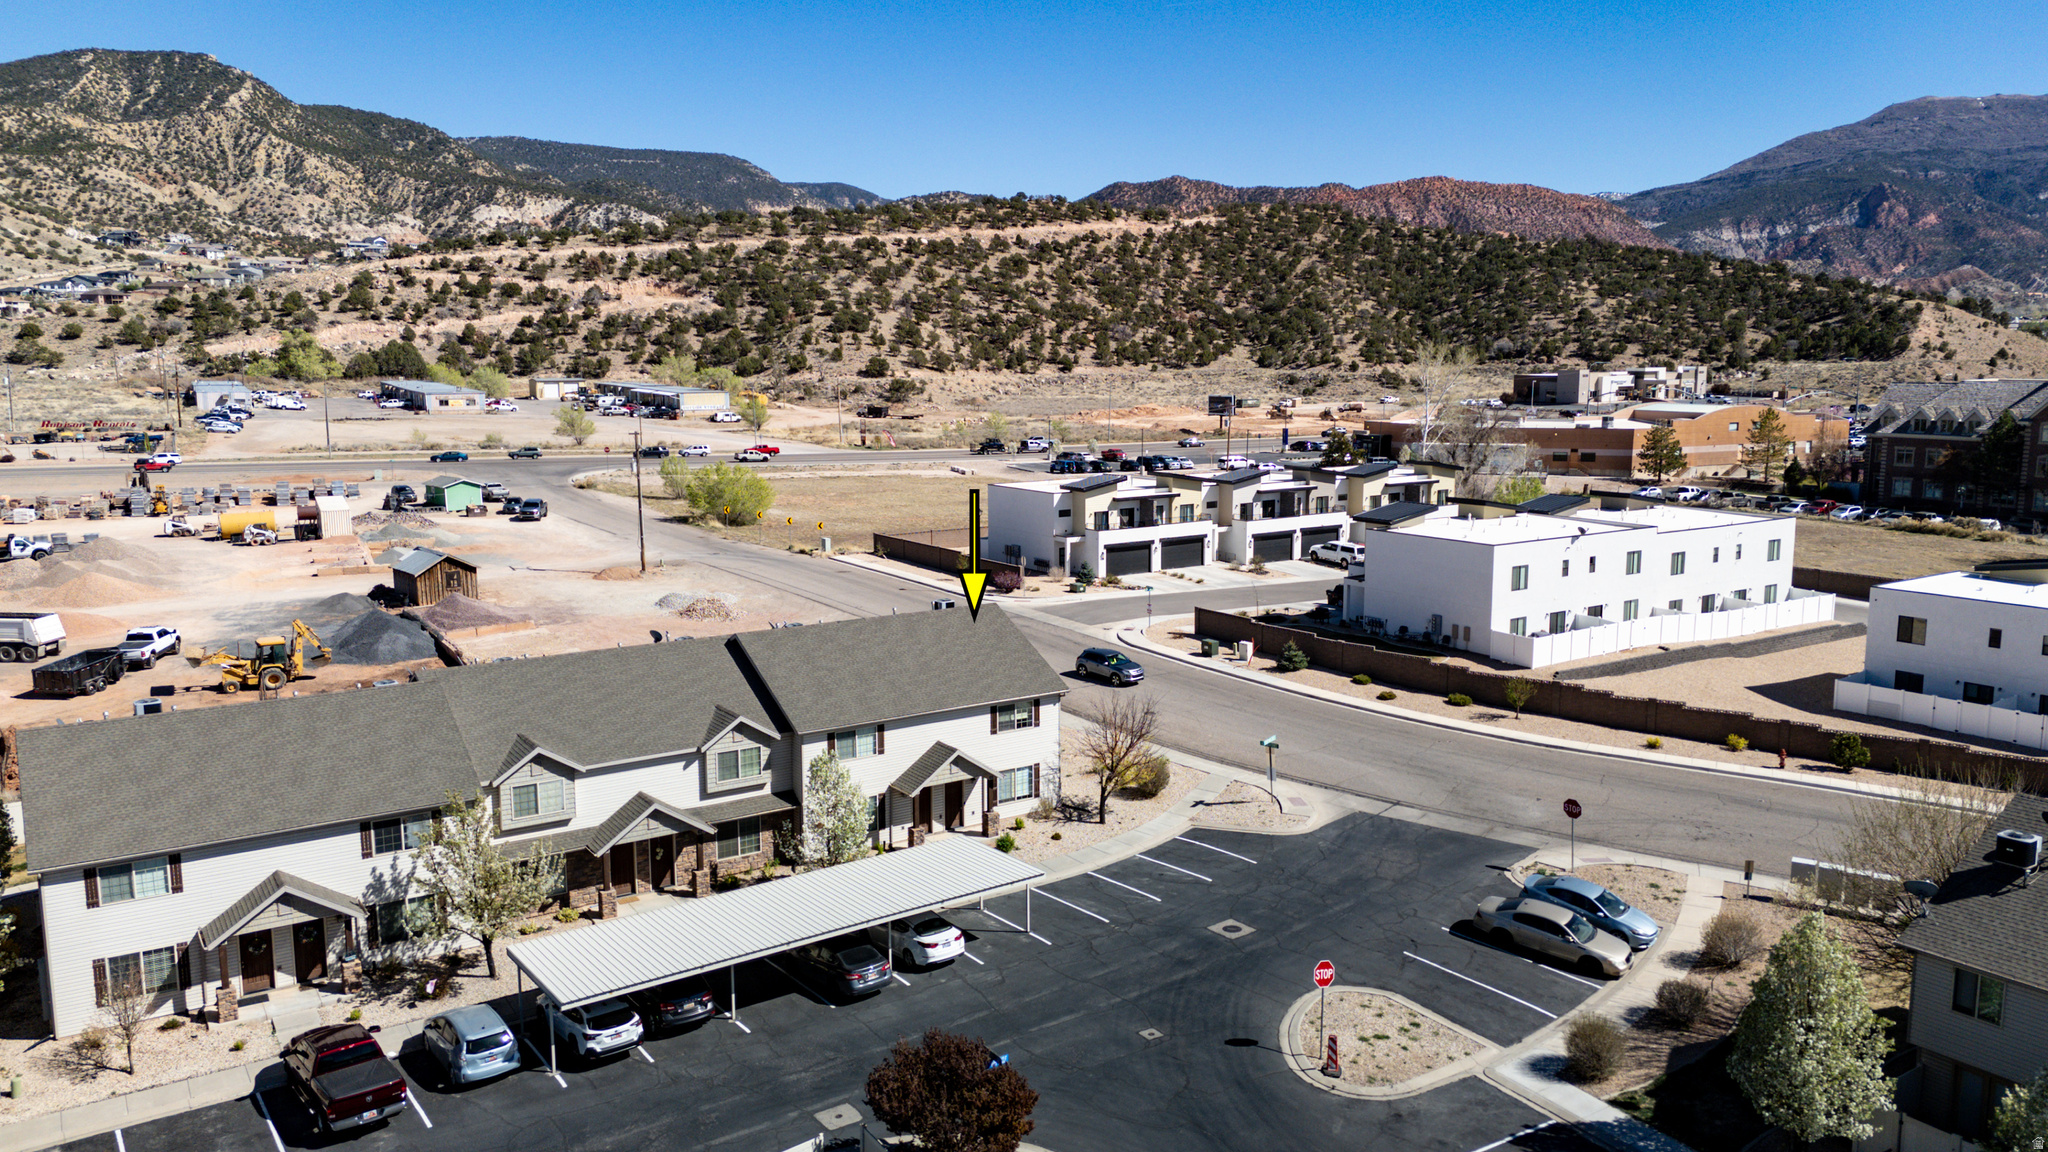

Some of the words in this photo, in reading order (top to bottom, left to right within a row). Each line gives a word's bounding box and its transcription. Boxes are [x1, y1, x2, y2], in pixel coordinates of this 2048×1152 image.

[41, 420, 86, 428] Robison
[93, 420, 137, 428] Rentals
[1564, 803, 1581, 814] STOP
[1315, 969, 1332, 980] STOP
